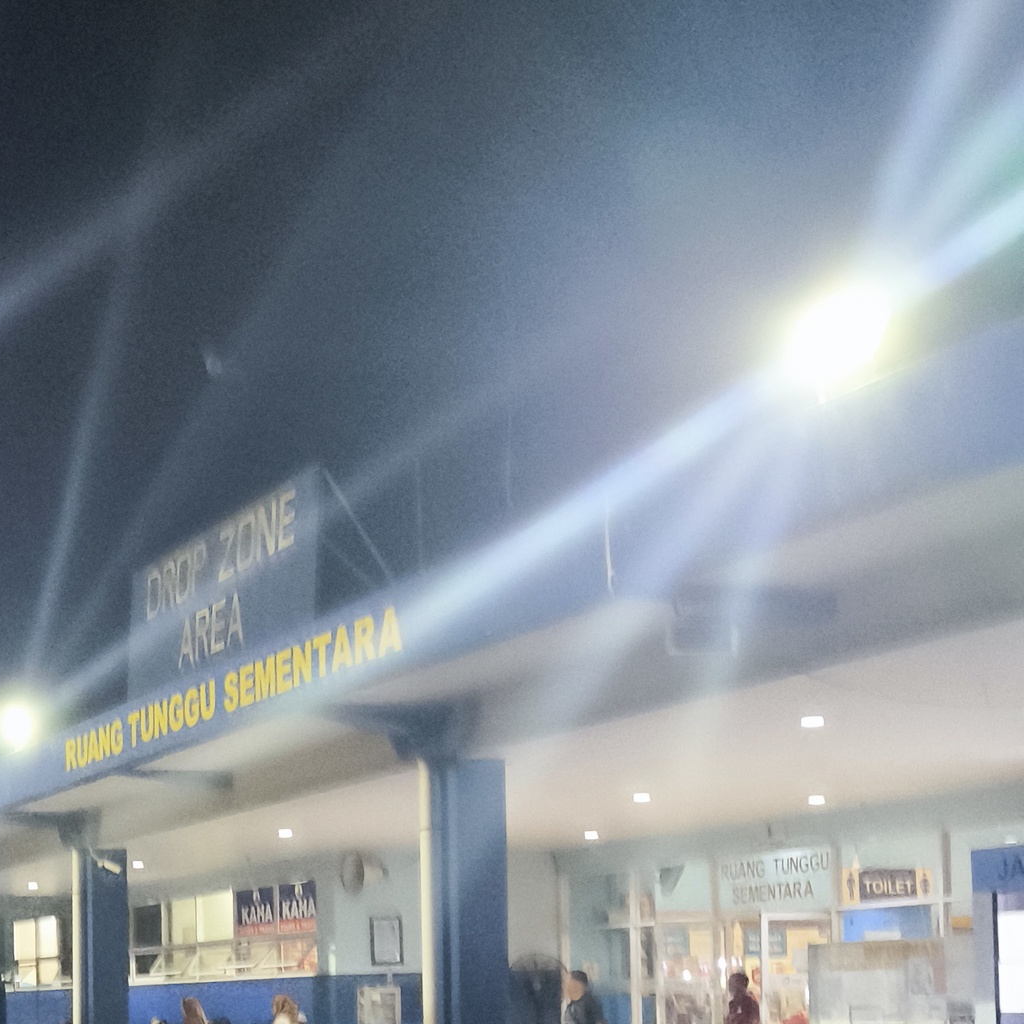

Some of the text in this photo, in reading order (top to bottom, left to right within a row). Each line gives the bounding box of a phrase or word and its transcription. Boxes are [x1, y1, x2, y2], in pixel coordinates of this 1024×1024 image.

[147, 487, 296, 621] DROP ZONE
[178, 592, 244, 669] AREA
[65, 605, 402, 772] RUANG TUNGGU SEMENTARA
[720, 851, 830, 881] RUANG TUNGGU
[864, 878, 914, 896] TOILET
[732, 880, 814, 906] SEMENTARA
